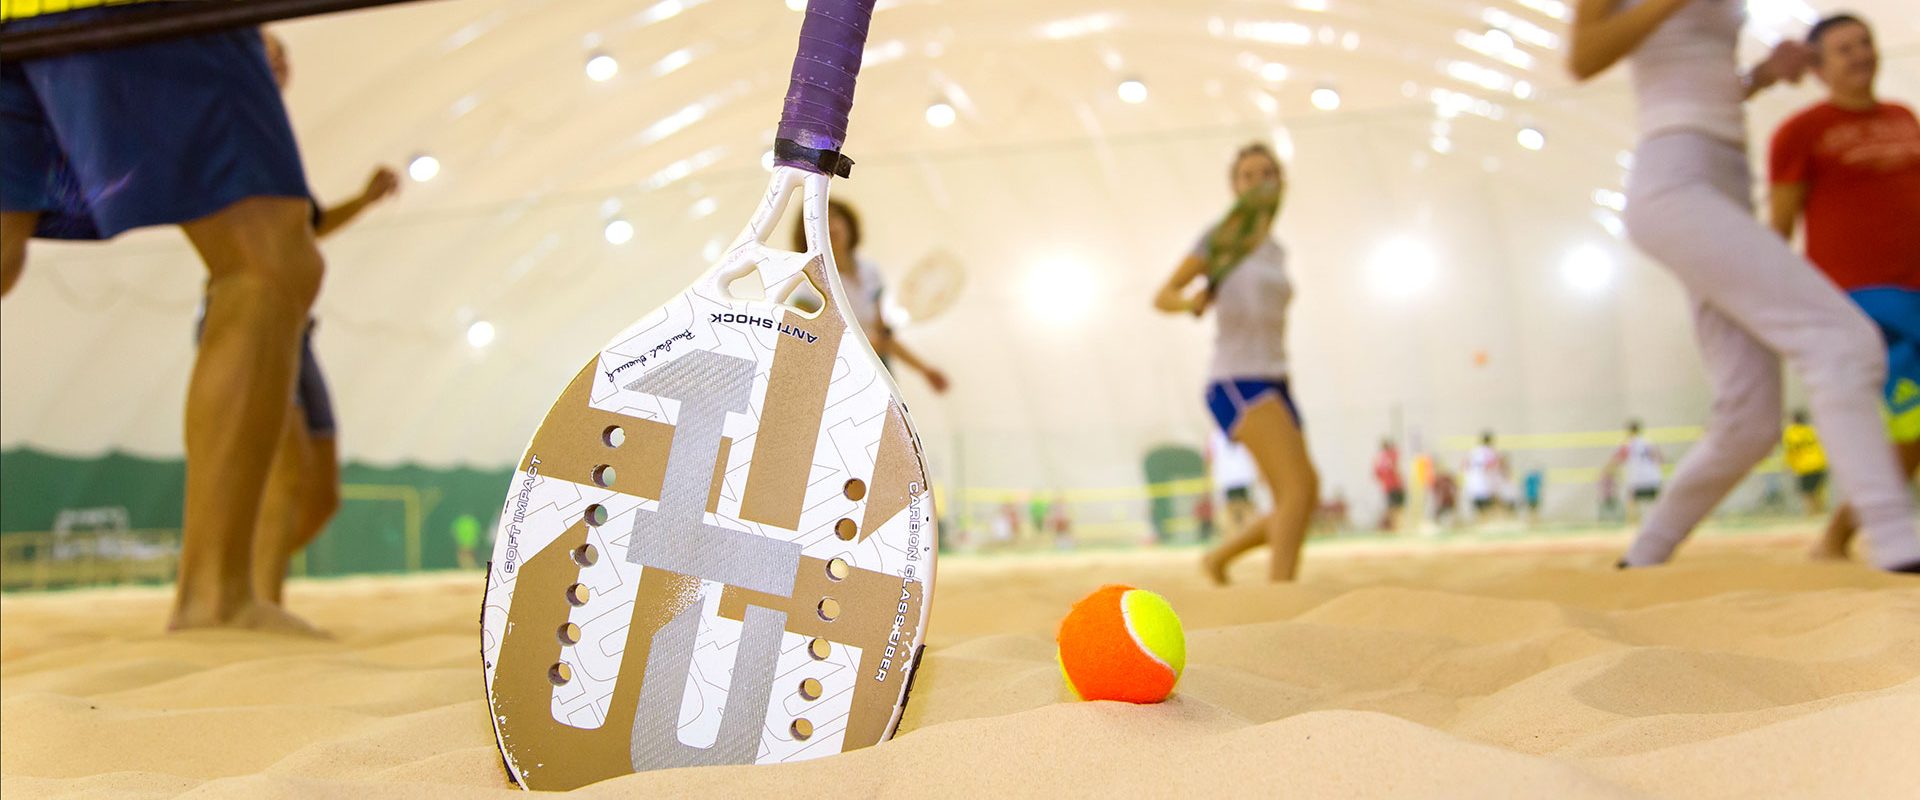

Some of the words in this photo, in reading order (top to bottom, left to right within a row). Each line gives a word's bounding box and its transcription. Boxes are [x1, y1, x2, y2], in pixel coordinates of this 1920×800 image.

[710, 313, 773, 329] SHOCK
[776, 322, 818, 344] ANTI
[504, 525, 521, 573] SOFT
[513, 454, 541, 523] IMPACT
[907, 481, 920, 561] CARBON
